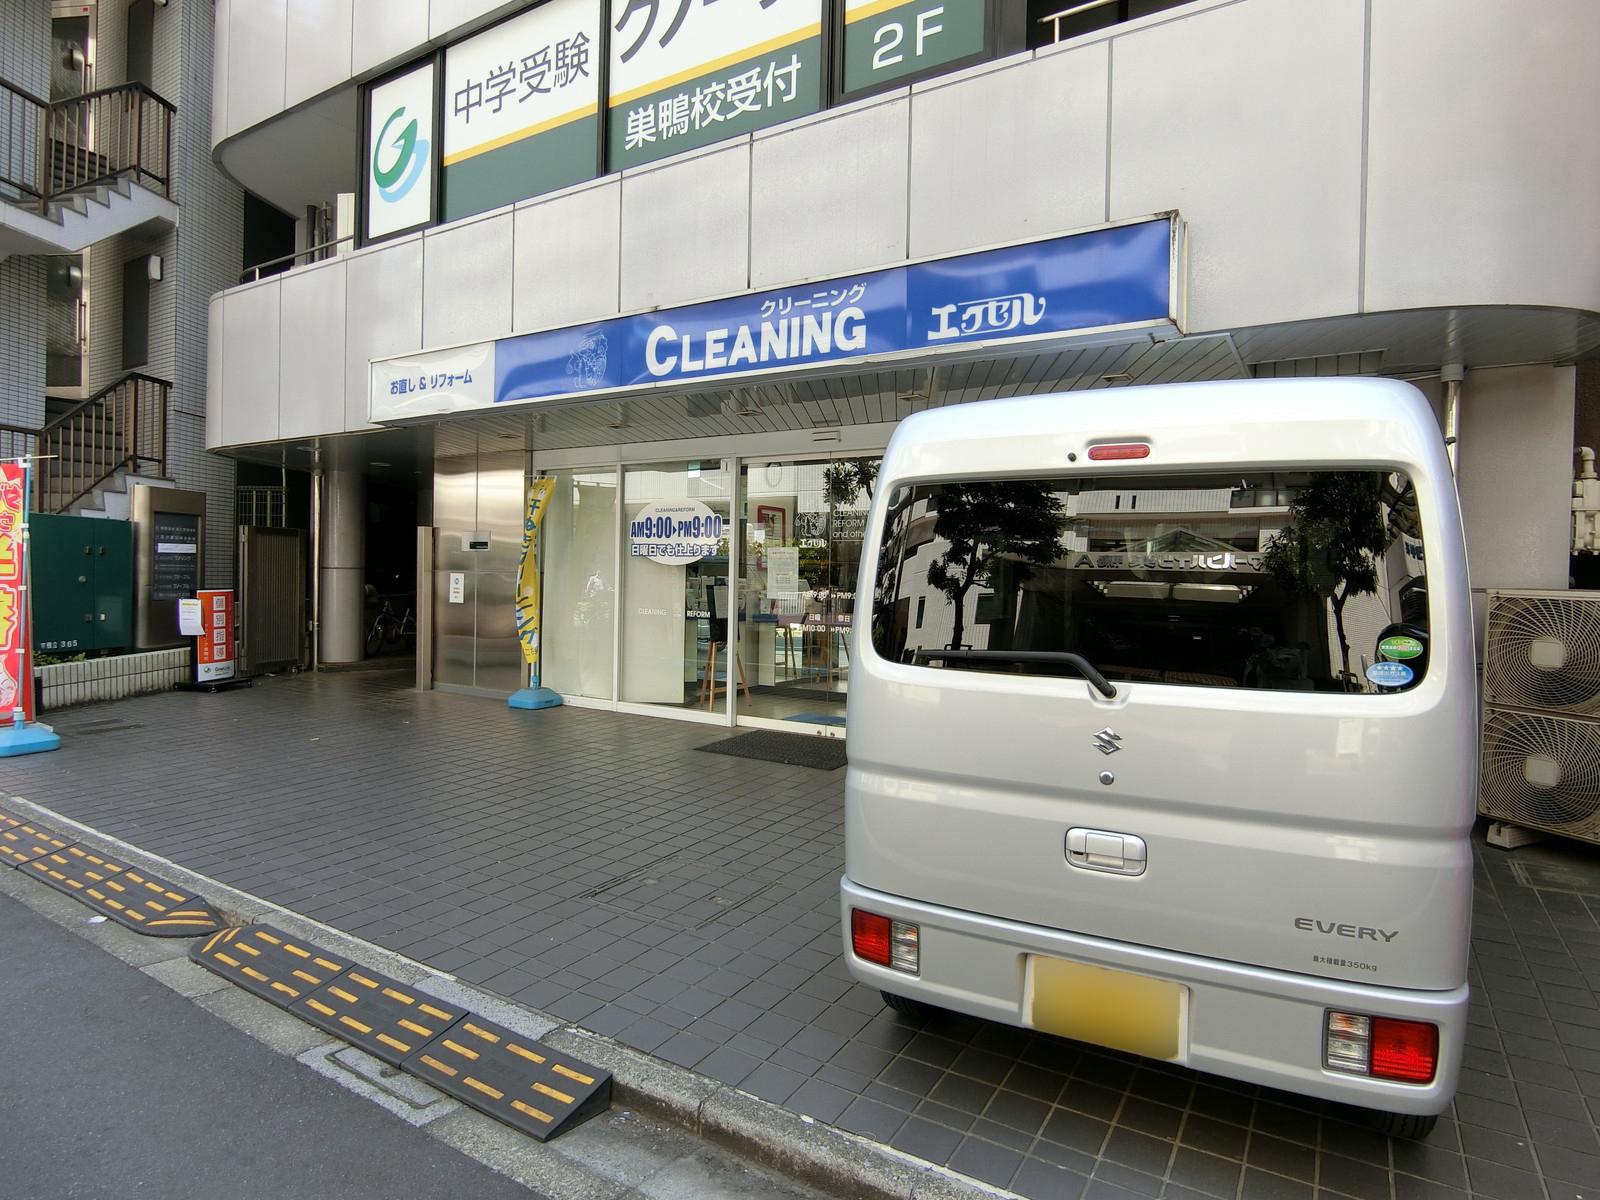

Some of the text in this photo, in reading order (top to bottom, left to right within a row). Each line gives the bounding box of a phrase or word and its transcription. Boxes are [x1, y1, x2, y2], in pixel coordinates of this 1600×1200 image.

[872, 5, 944, 70] 2F
[454, 31, 590, 124] 中学受験
[624, 53, 802, 151] 巣鴨校受付
[760, 282, 867, 319] クリーニング
[927, 292, 1046, 341] エクセル
[645, 307, 867, 377] CLEANING
[390, 368, 473, 395] お直し & リフォーム
[833, 519, 865, 527] REFORM
[849, 530, 866, 538] othe
[631, 543, 720, 557] 日曜日でも仕上ります
[686, 610, 711, 618] REFORM
[60, 639, 78, 648] 365
[1294, 917, 1399, 943] EVERY
[1312, 954, 1378, 973] 最大積載量350kg
